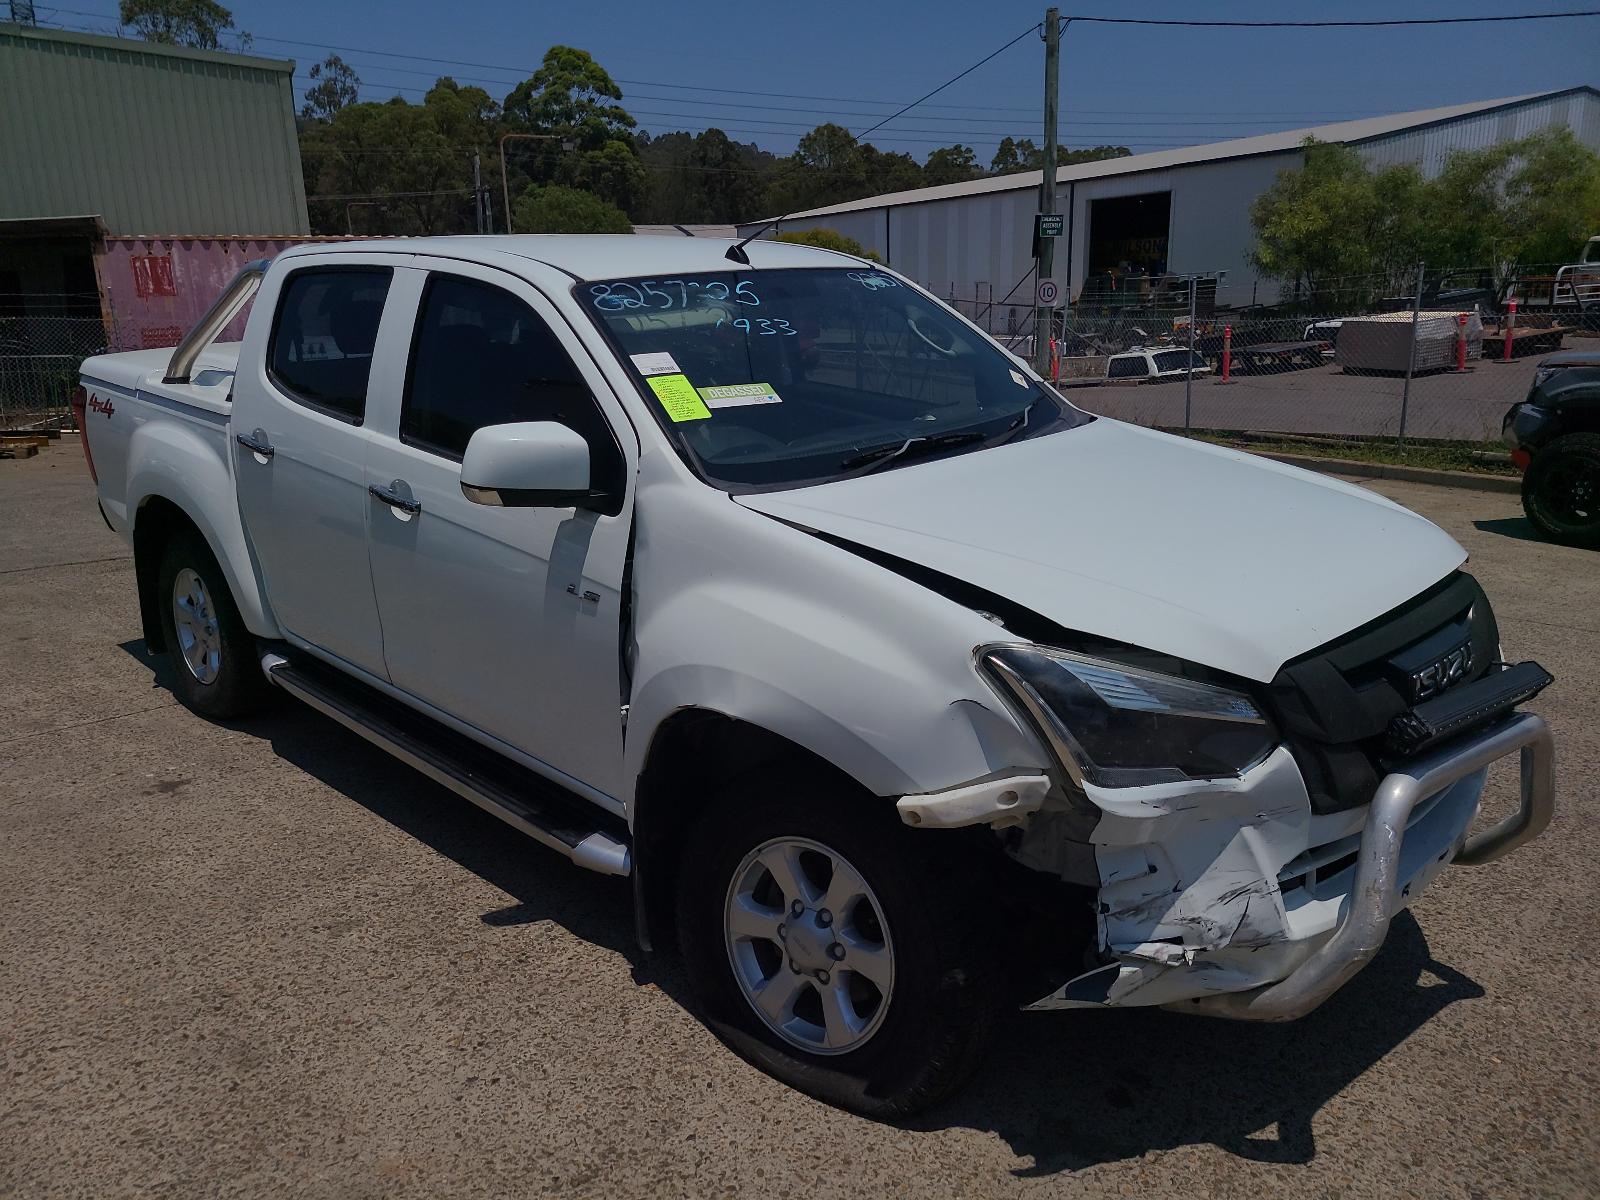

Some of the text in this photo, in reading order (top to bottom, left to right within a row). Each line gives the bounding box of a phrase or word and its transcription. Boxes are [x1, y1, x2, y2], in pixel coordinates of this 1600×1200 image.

[1042, 287, 1054, 298] 10
[707, 385, 767, 399] DEGASSED
[1411, 640, 1475, 700] ISUZU
